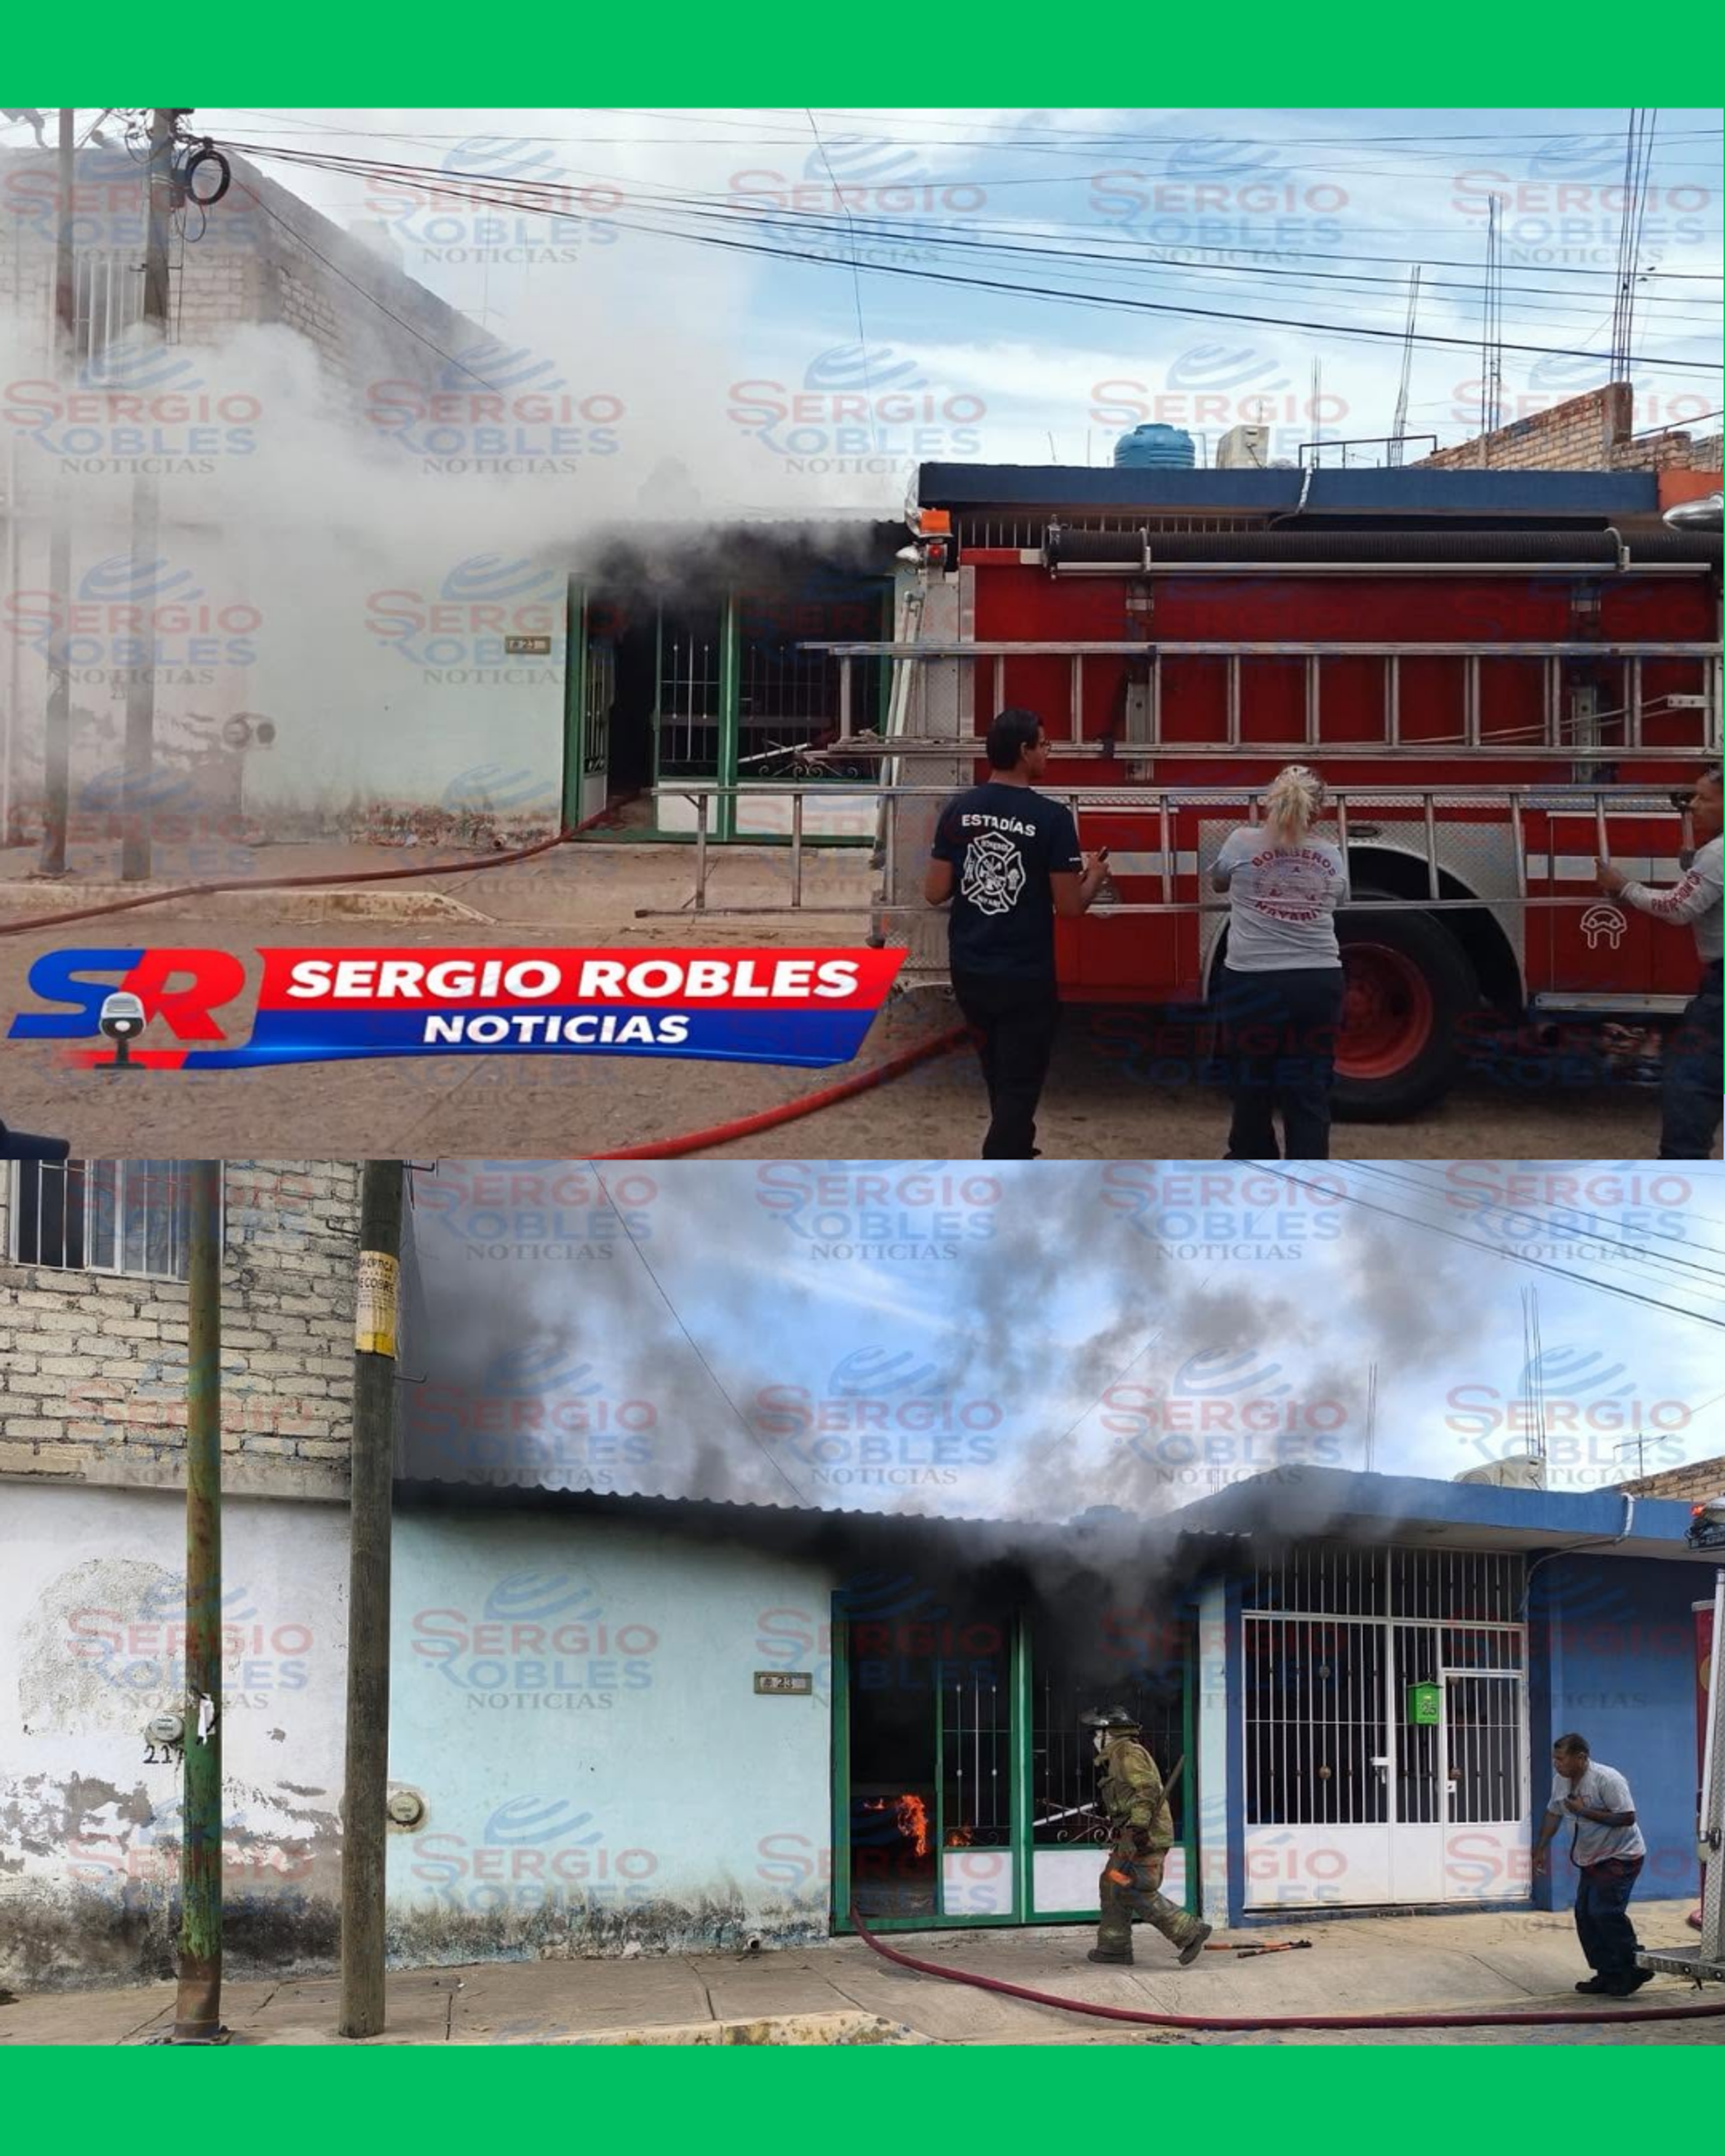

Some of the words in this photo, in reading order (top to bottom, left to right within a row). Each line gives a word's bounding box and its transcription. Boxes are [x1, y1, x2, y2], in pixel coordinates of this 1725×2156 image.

[961, 814, 1036, 836] ESTADÍAS
[1255, 900, 1320, 921] NAYARI
[778, 1677, 793, 1688] 23
